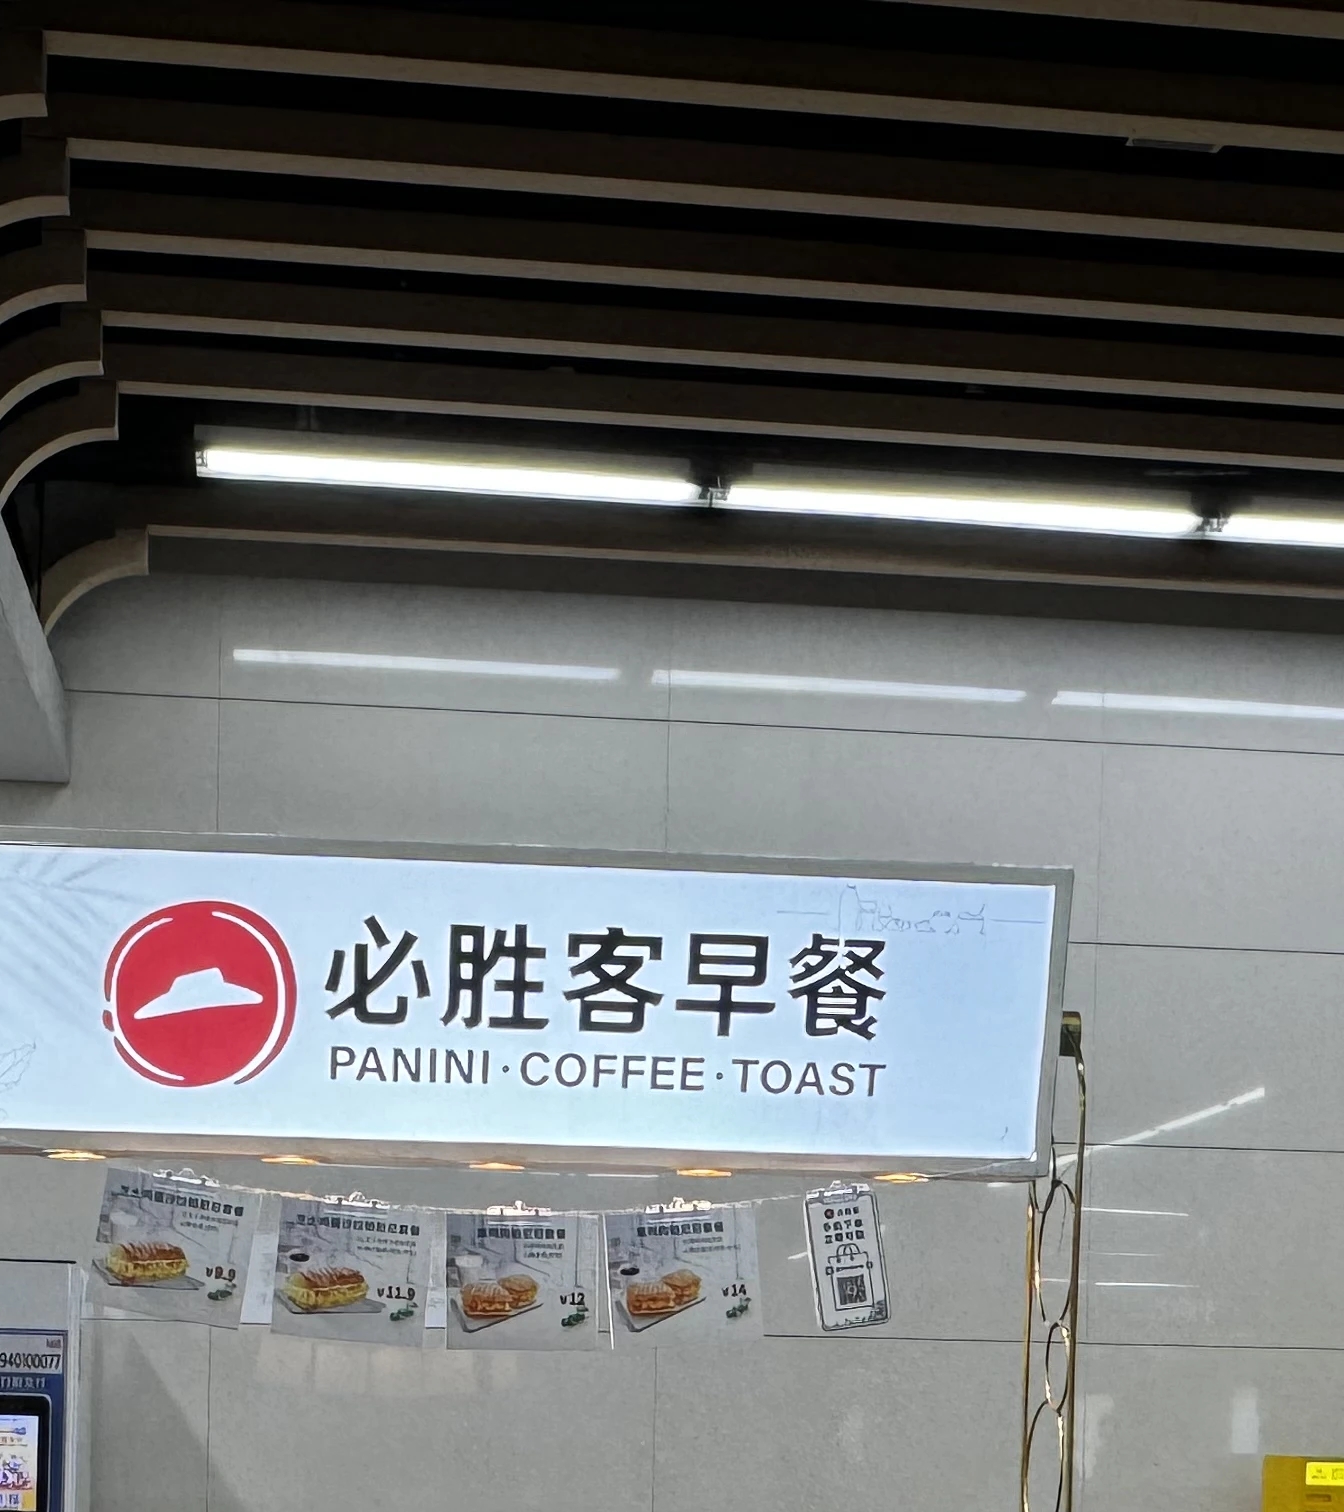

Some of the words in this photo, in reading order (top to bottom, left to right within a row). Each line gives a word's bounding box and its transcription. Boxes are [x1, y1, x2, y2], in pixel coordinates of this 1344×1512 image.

[325, 916, 887, 1040] 必胜客早餐
